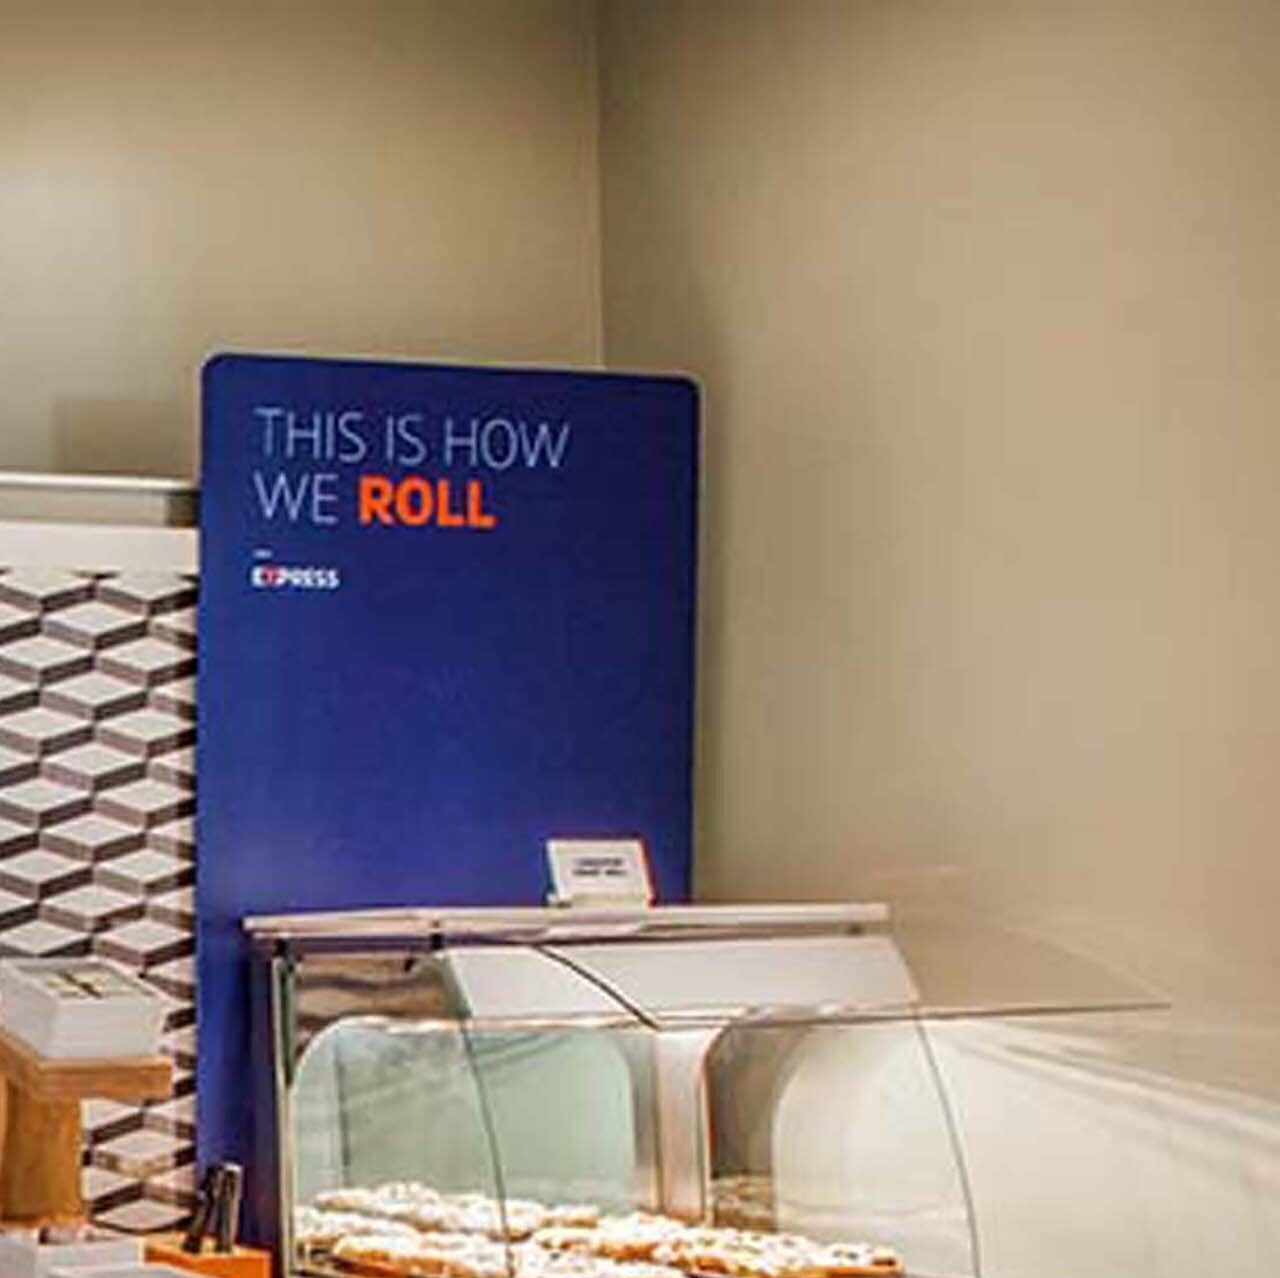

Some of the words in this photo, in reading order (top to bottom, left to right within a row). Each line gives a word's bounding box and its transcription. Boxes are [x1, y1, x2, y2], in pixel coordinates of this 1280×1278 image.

[254, 409, 366, 463] THIS
[387, 413, 427, 466] IS
[445, 420, 570, 469] HOW
[254, 472, 339, 524] WE
[358, 475, 497, 528] ROLL
